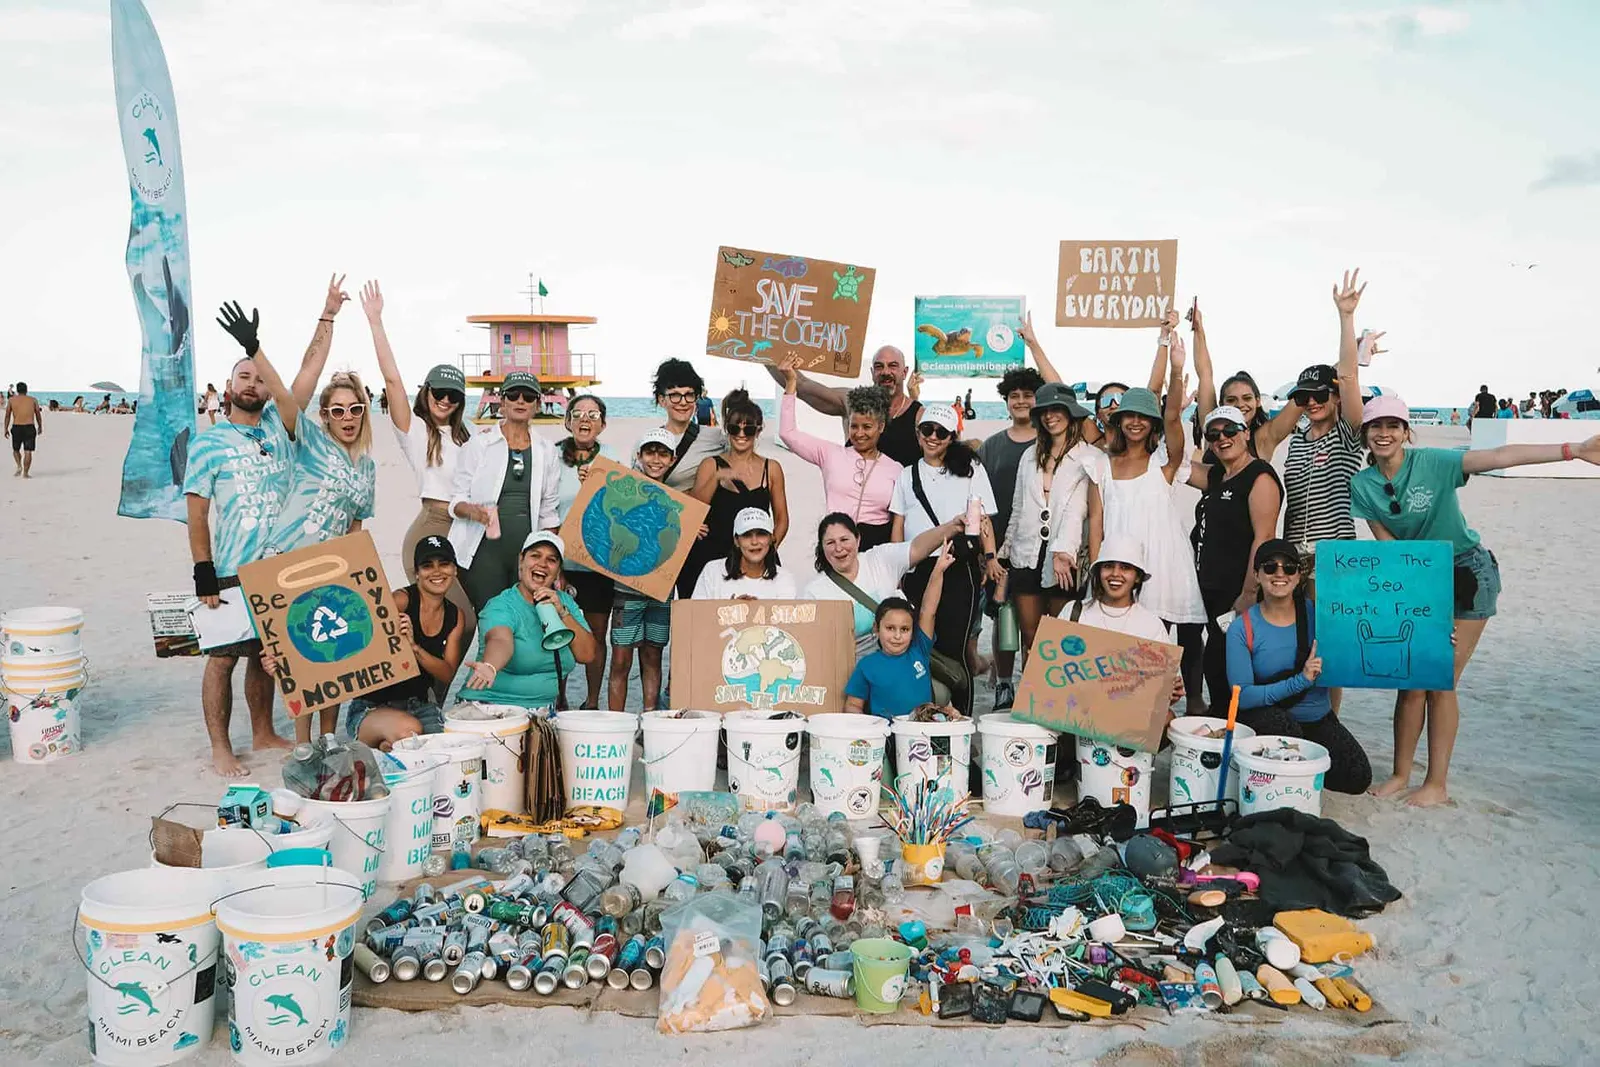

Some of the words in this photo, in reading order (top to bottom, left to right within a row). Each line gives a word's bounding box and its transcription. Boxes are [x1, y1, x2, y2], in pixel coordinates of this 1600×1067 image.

[132, 94, 162, 120] CLEAN
[154, 168, 173, 198] BEACH
[1080, 247, 1160, 273] EARTH
[1099, 275, 1136, 291] DAY
[752, 279, 818, 320] SAVE
[1065, 294, 1170, 320] EVERYDAY
[735, 311, 782, 341] THE
[782, 318, 850, 352] OCEANS
[1334, 552, 1381, 570] Keep
[1400, 554, 1434, 568] The
[350, 567, 378, 585] TO
[1368, 576, 1404, 592] Sea
[249, 593, 287, 616] Be
[717, 603, 749, 625] SKIP
[752, 605, 766, 625] A
[770, 604, 816, 624] STRAW
[1331, 601, 1379, 616] Plastic
[1395, 601, 1432, 617] Free
[368, 586, 402, 655] YOUR
[261, 618, 297, 694] KIND
[302, 661, 395, 708] MOTHER
[715, 684, 746, 704] SAVE
[751, 691, 774, 710] THE
[777, 685, 828, 705] PLANET
[574, 744, 627, 759] CLEAN
[576, 765, 624, 779] MIAMI
[571, 786, 625, 801] BEACH
[1265, 786, 1312, 801] CLEAN
[100, 950, 171, 975] CLEAN
[249, 963, 322, 986] CLEAN
[98, 1017, 132, 1047] MIAMI
[137, 1009, 183, 1047] BEACH
[245, 1026, 280, 1056] MIAMI
[285, 1019, 329, 1056] BEACH
